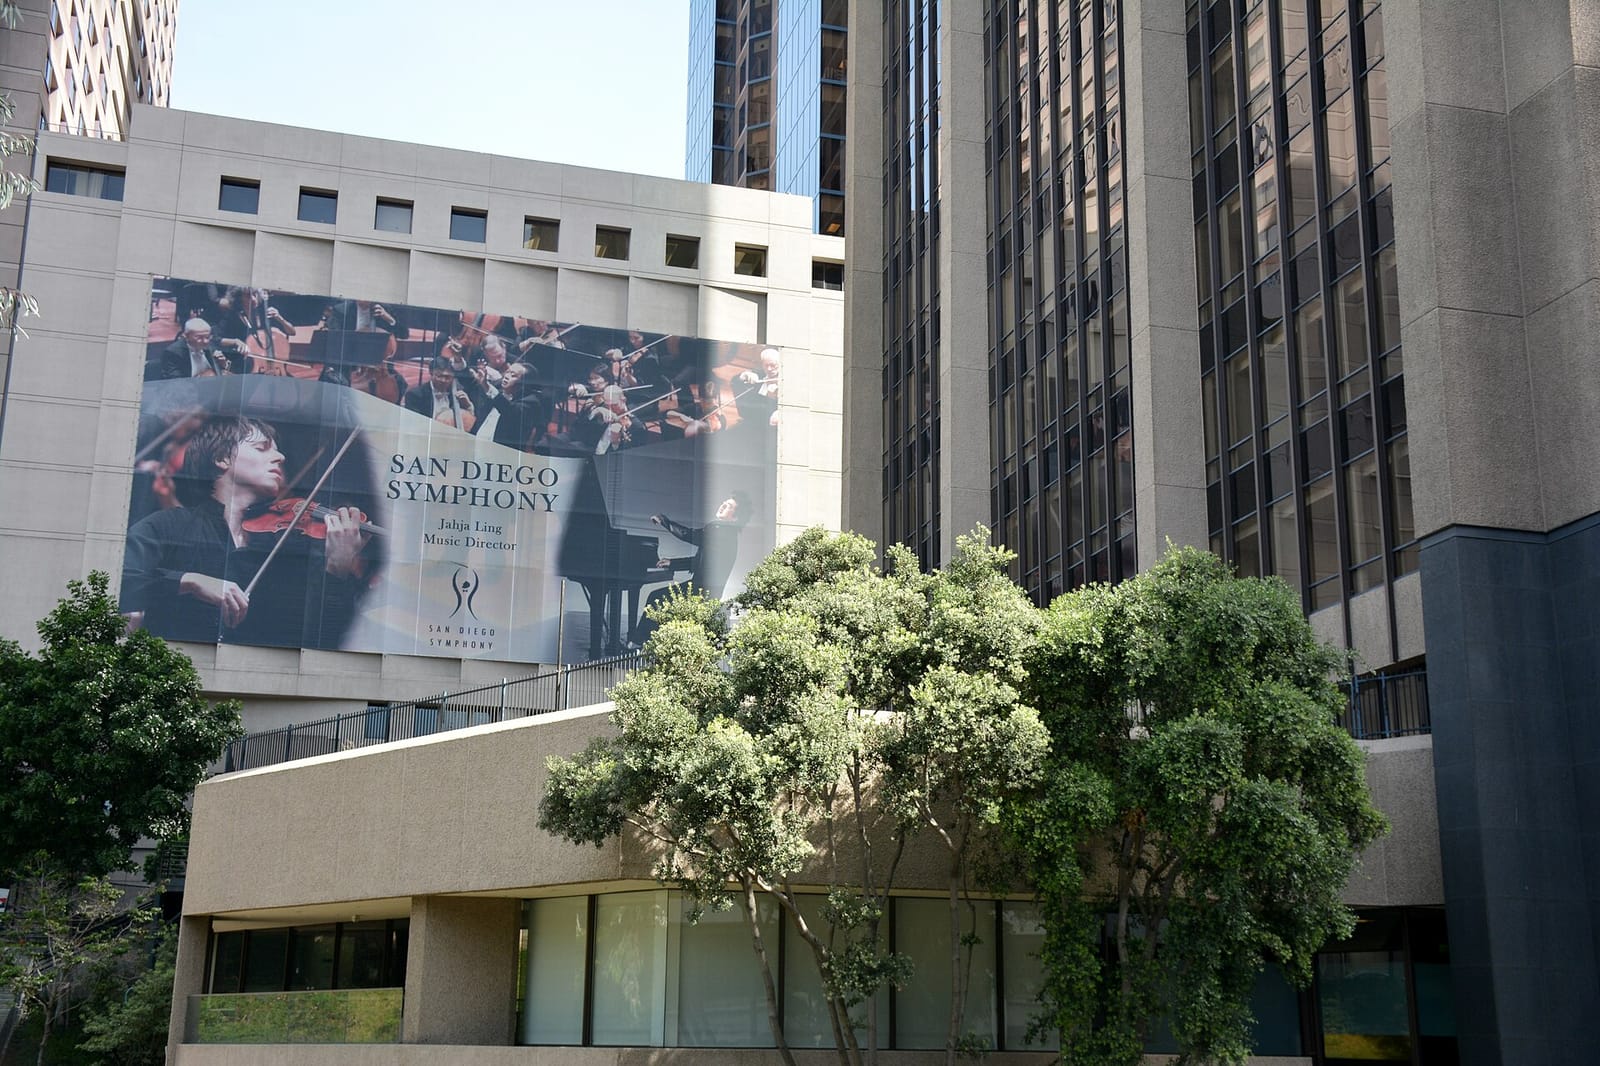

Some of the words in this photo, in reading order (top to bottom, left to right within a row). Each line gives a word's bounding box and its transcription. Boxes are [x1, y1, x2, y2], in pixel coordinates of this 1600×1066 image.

[390, 454, 449, 477] SAN
[460, 460, 559, 487] DIEGO
[386, 480, 560, 513] SYMPHONY
[438, 518, 470, 531] Jahja
[474, 521, 503, 536] Ling
[423, 533, 461, 547] Music
[464, 536, 518, 551] Director
[428, 624, 450, 634] SAN
[459, 626, 496, 637] DIEGO
[429, 638, 494, 650] SYMPHONY
